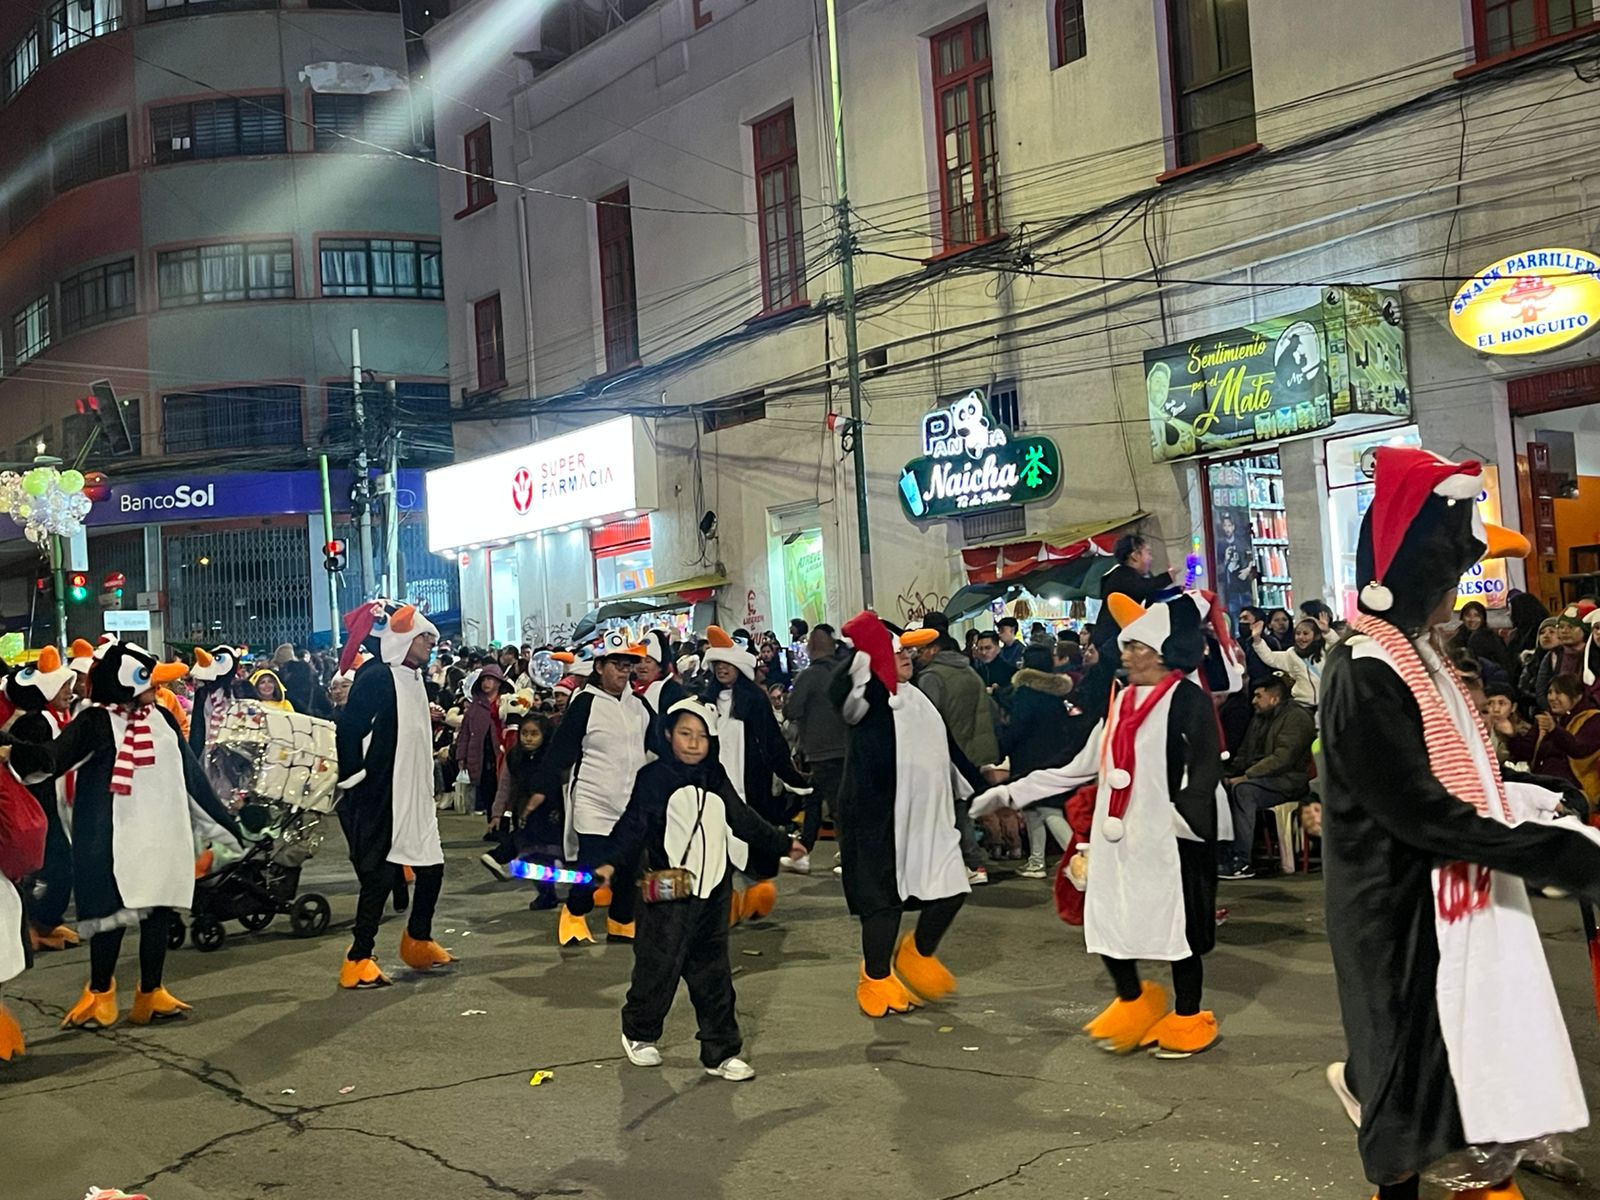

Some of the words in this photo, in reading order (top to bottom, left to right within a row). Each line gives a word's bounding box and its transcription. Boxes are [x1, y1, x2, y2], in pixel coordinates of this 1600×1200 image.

[1454, 267, 1502, 314] SNACK
[1478, 334, 1496, 348] EL
[1501, 314, 1589, 342] HONGUITO
[1187, 333, 1267, 374] Sentimiento
[1193, 365, 1274, 436] Mate
[922, 409, 1008, 458] PANA
[541, 452, 586, 479] SUPER
[541, 467, 614, 499] FARMACIA
[922, 454, 1020, 501] Naicha
[120, 484, 215, 513] BancoSol
[1456, 579, 1505, 595] RESCO
